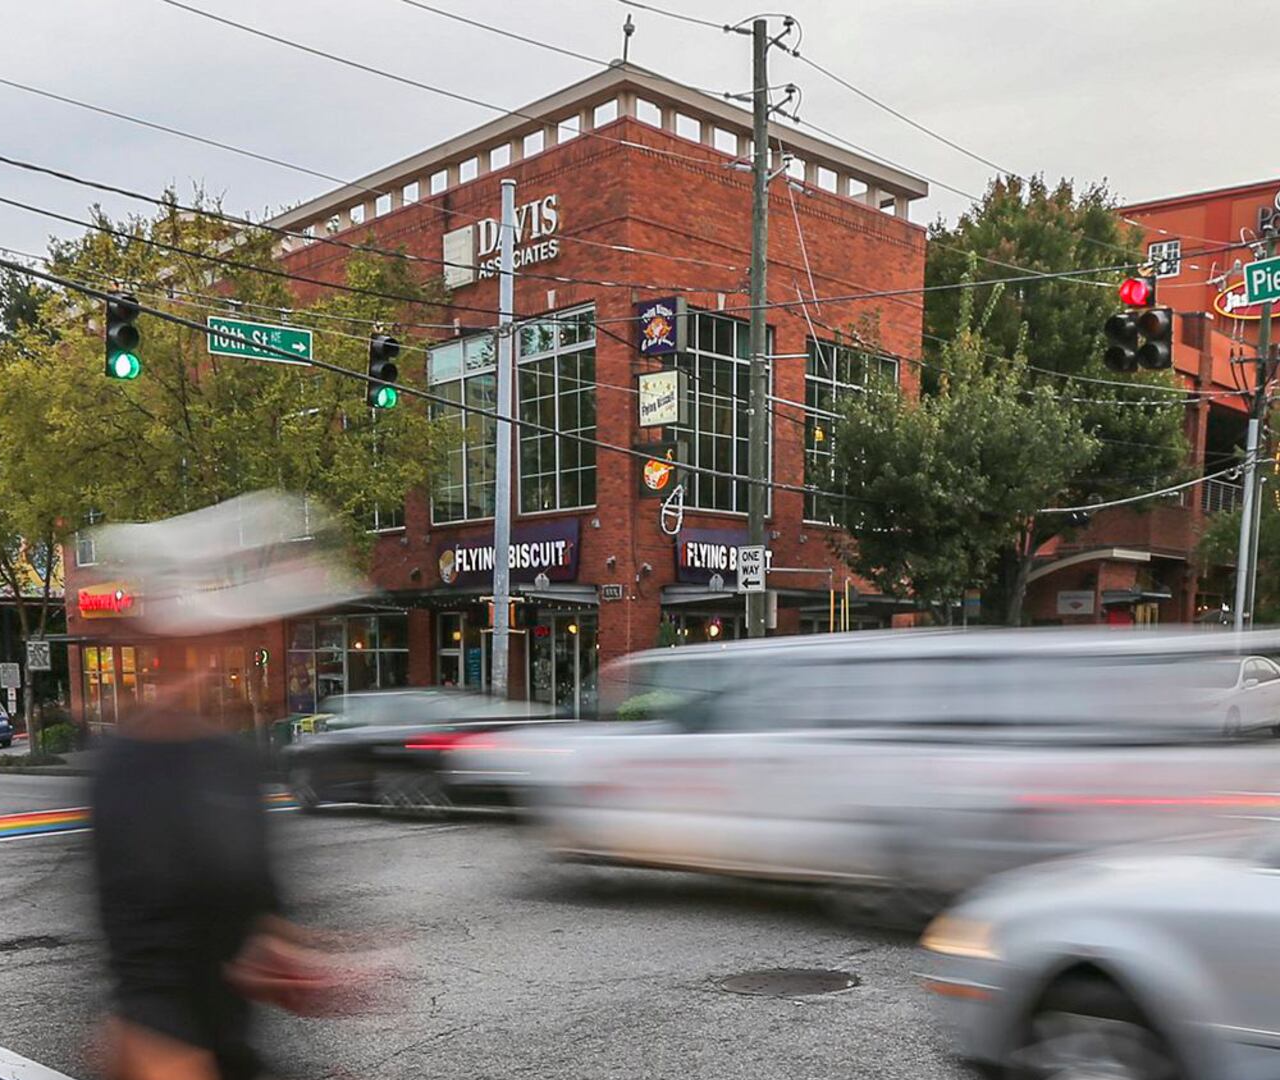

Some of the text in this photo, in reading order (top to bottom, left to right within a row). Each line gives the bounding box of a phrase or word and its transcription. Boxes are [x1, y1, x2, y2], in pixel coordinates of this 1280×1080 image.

[478, 239, 559, 279] ASSCIATES
[213, 324, 245, 350] 10th
[252, 330, 269, 352] St
[509, 540, 566, 568] BISCUIT
[686, 542, 728, 569] FLYING
[742, 551, 760, 562] ONE
[741, 564, 760, 576] WAY
